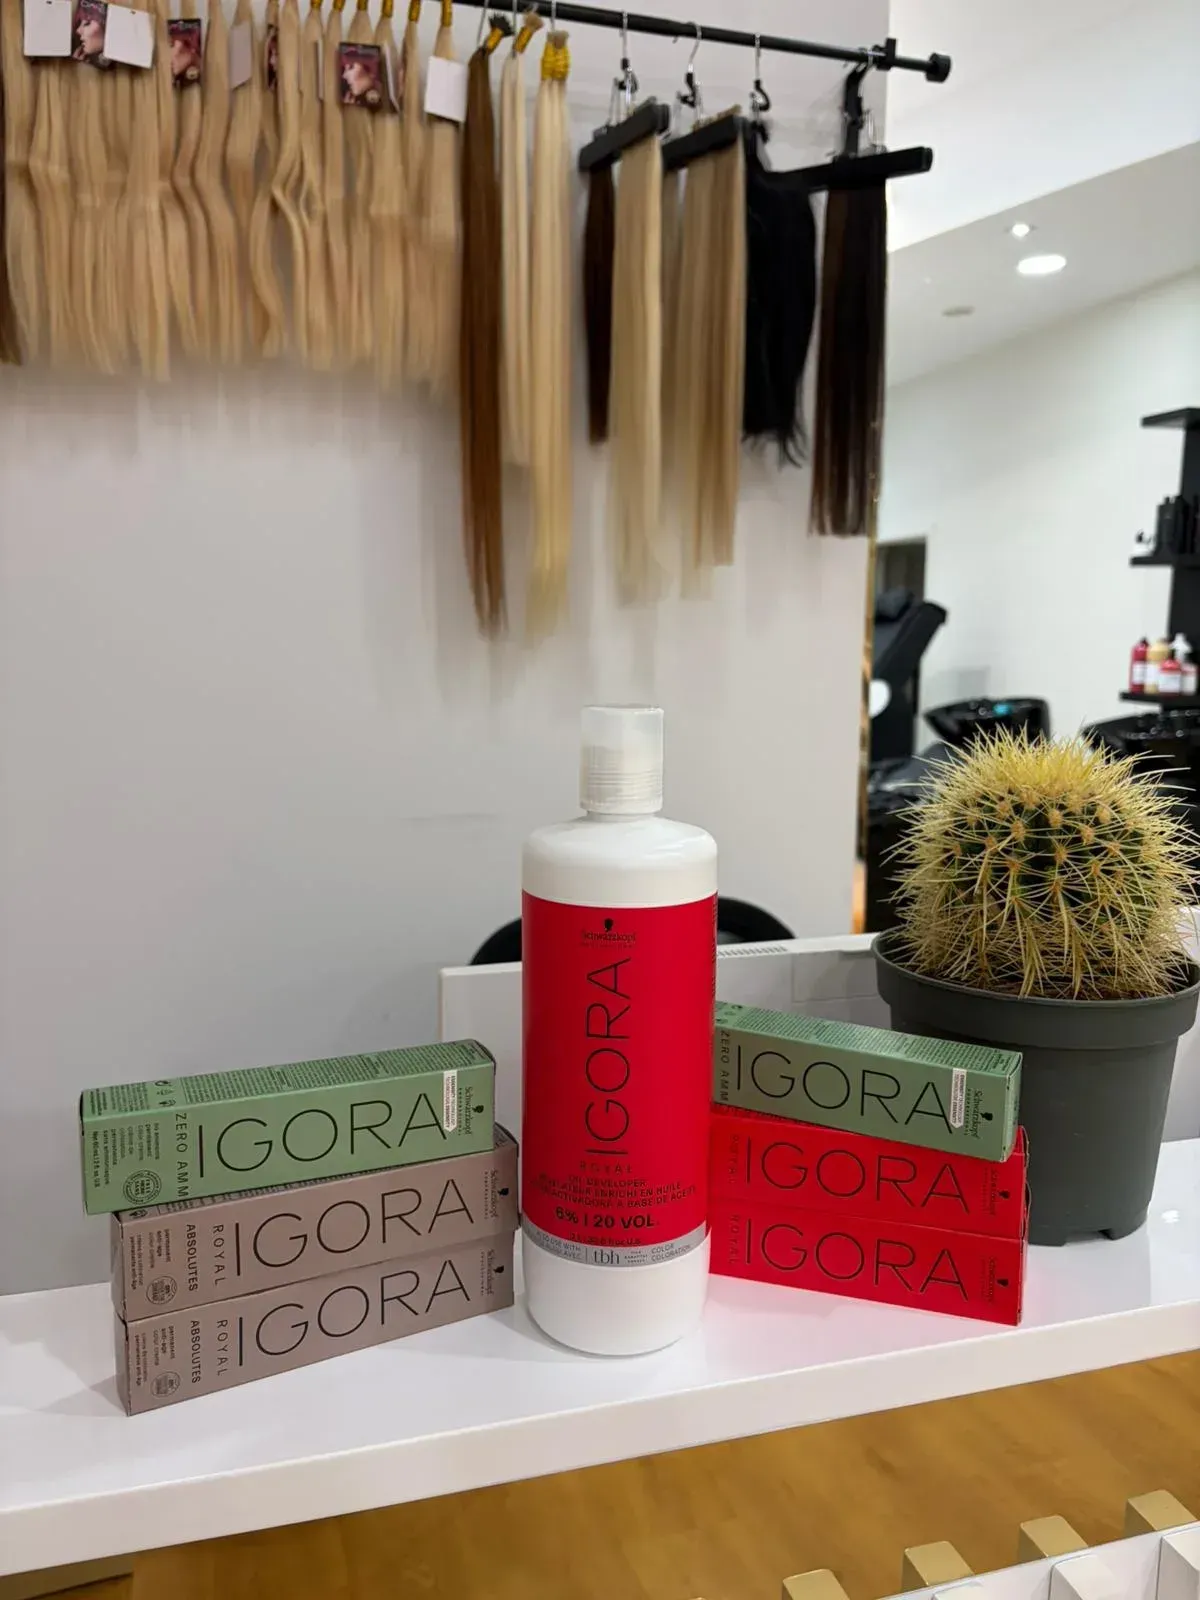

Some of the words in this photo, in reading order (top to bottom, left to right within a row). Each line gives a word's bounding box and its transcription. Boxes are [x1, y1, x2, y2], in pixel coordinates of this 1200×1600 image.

[585, 957, 631, 1155] IGORA
[720, 1030, 731, 1064] ZERO
[719, 1070, 731, 1102] AMM
[737, 1045, 953, 1135] IGORA
[970, 1089, 983, 1140] Schwarzkopf
[175, 1112, 189, 1153] ZERO
[199, 1092, 447, 1178] IGORA
[176, 1161, 190, 1198] AMM
[746, 1137, 970, 1214] IGORA
[235, 1178, 474, 1277] IGORA
[556, 1206, 579, 1224] 6%
[593, 1214, 615, 1229] 20
[186, 1224, 198, 1292] ABSOLUTES
[212, 1224, 226, 1286] ROYAL
[593, 1248, 620, 1266] tbh
[746, 1218, 968, 1302] IGORA
[239, 1259, 470, 1367] IGORA
[190, 1320, 202, 1384] ABSOLUTES
[217, 1319, 228, 1377] ROYAL
